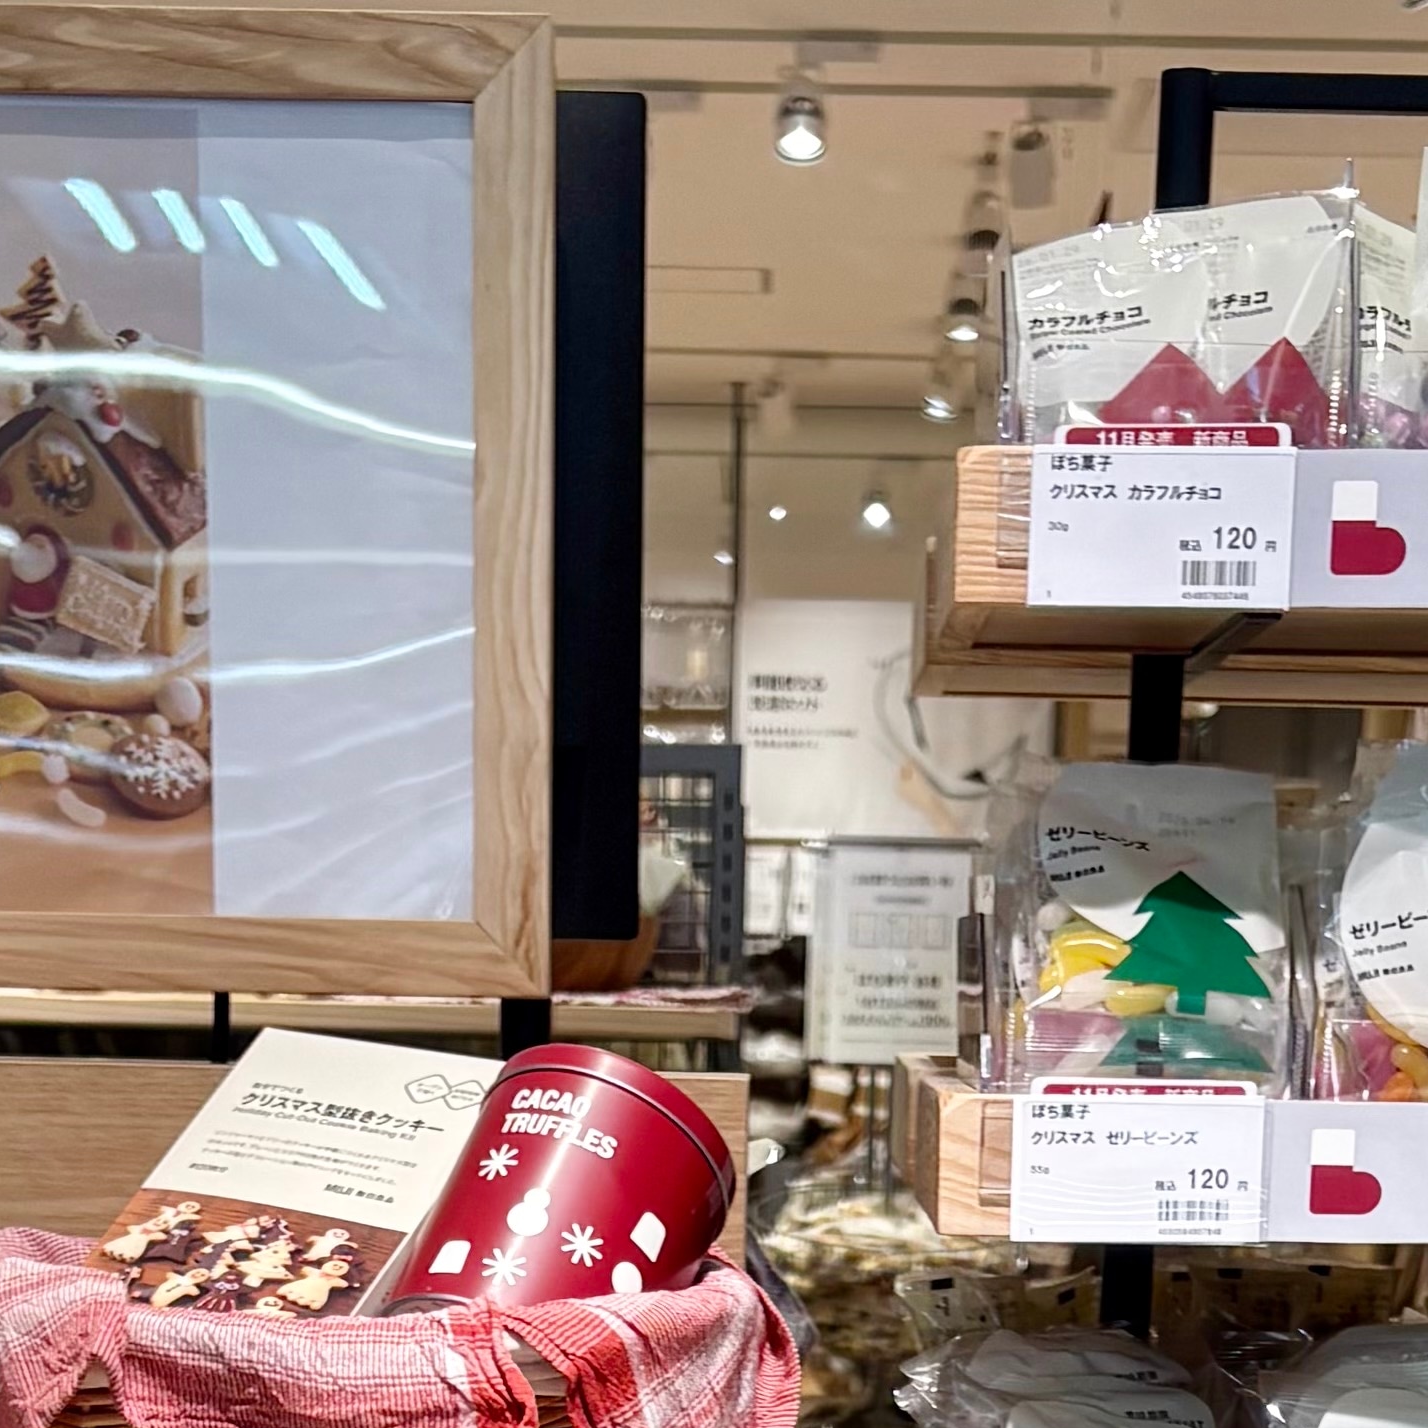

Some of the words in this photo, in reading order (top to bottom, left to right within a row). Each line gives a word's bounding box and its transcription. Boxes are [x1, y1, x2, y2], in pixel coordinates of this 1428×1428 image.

[1049, 484, 1118, 501] クリスマス
[1129, 483, 1221, 500] カラフルチョコ
[1212, 527, 1257, 551] 120
[511, 1088, 593, 1122] CACAO
[502, 1111, 619, 1160] TRUFFLES
[1030, 1129, 1095, 1146] クリスマス
[1105, 1129, 1198, 1146] ゼリービーンズ
[1187, 1167, 1229, 1190] 120
